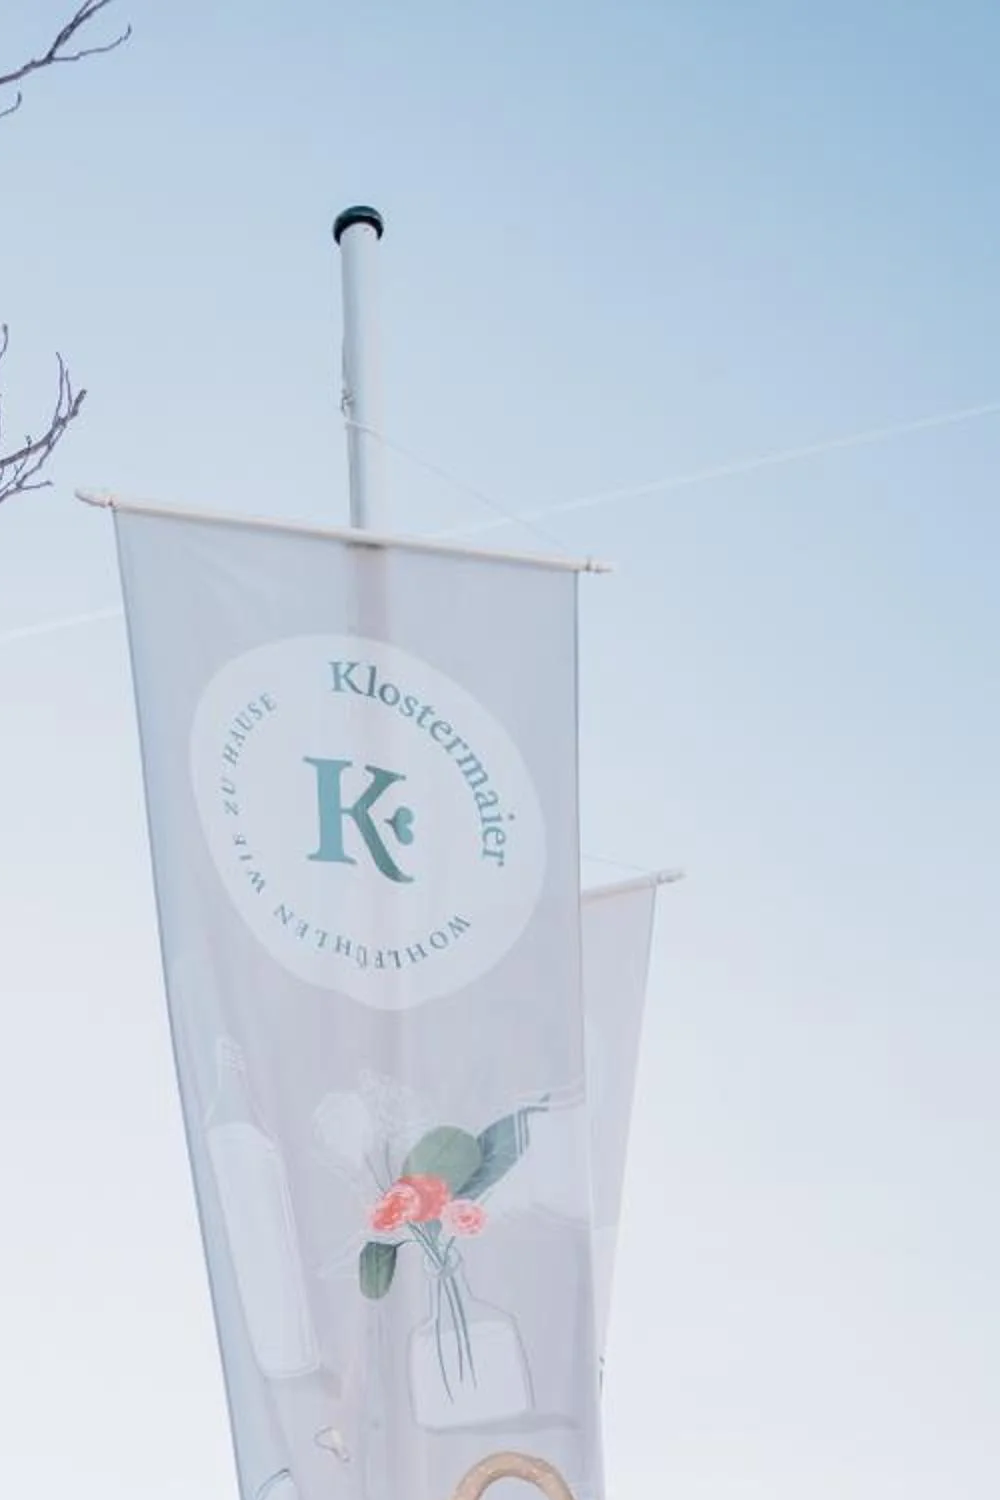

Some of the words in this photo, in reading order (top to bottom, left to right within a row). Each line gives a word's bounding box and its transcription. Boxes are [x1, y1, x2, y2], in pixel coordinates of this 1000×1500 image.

[222, 691, 278, 766] HAUSE
[328, 660, 516, 868] Klostermaier
[273, 904, 472, 970] WOHLFÜHLEN
